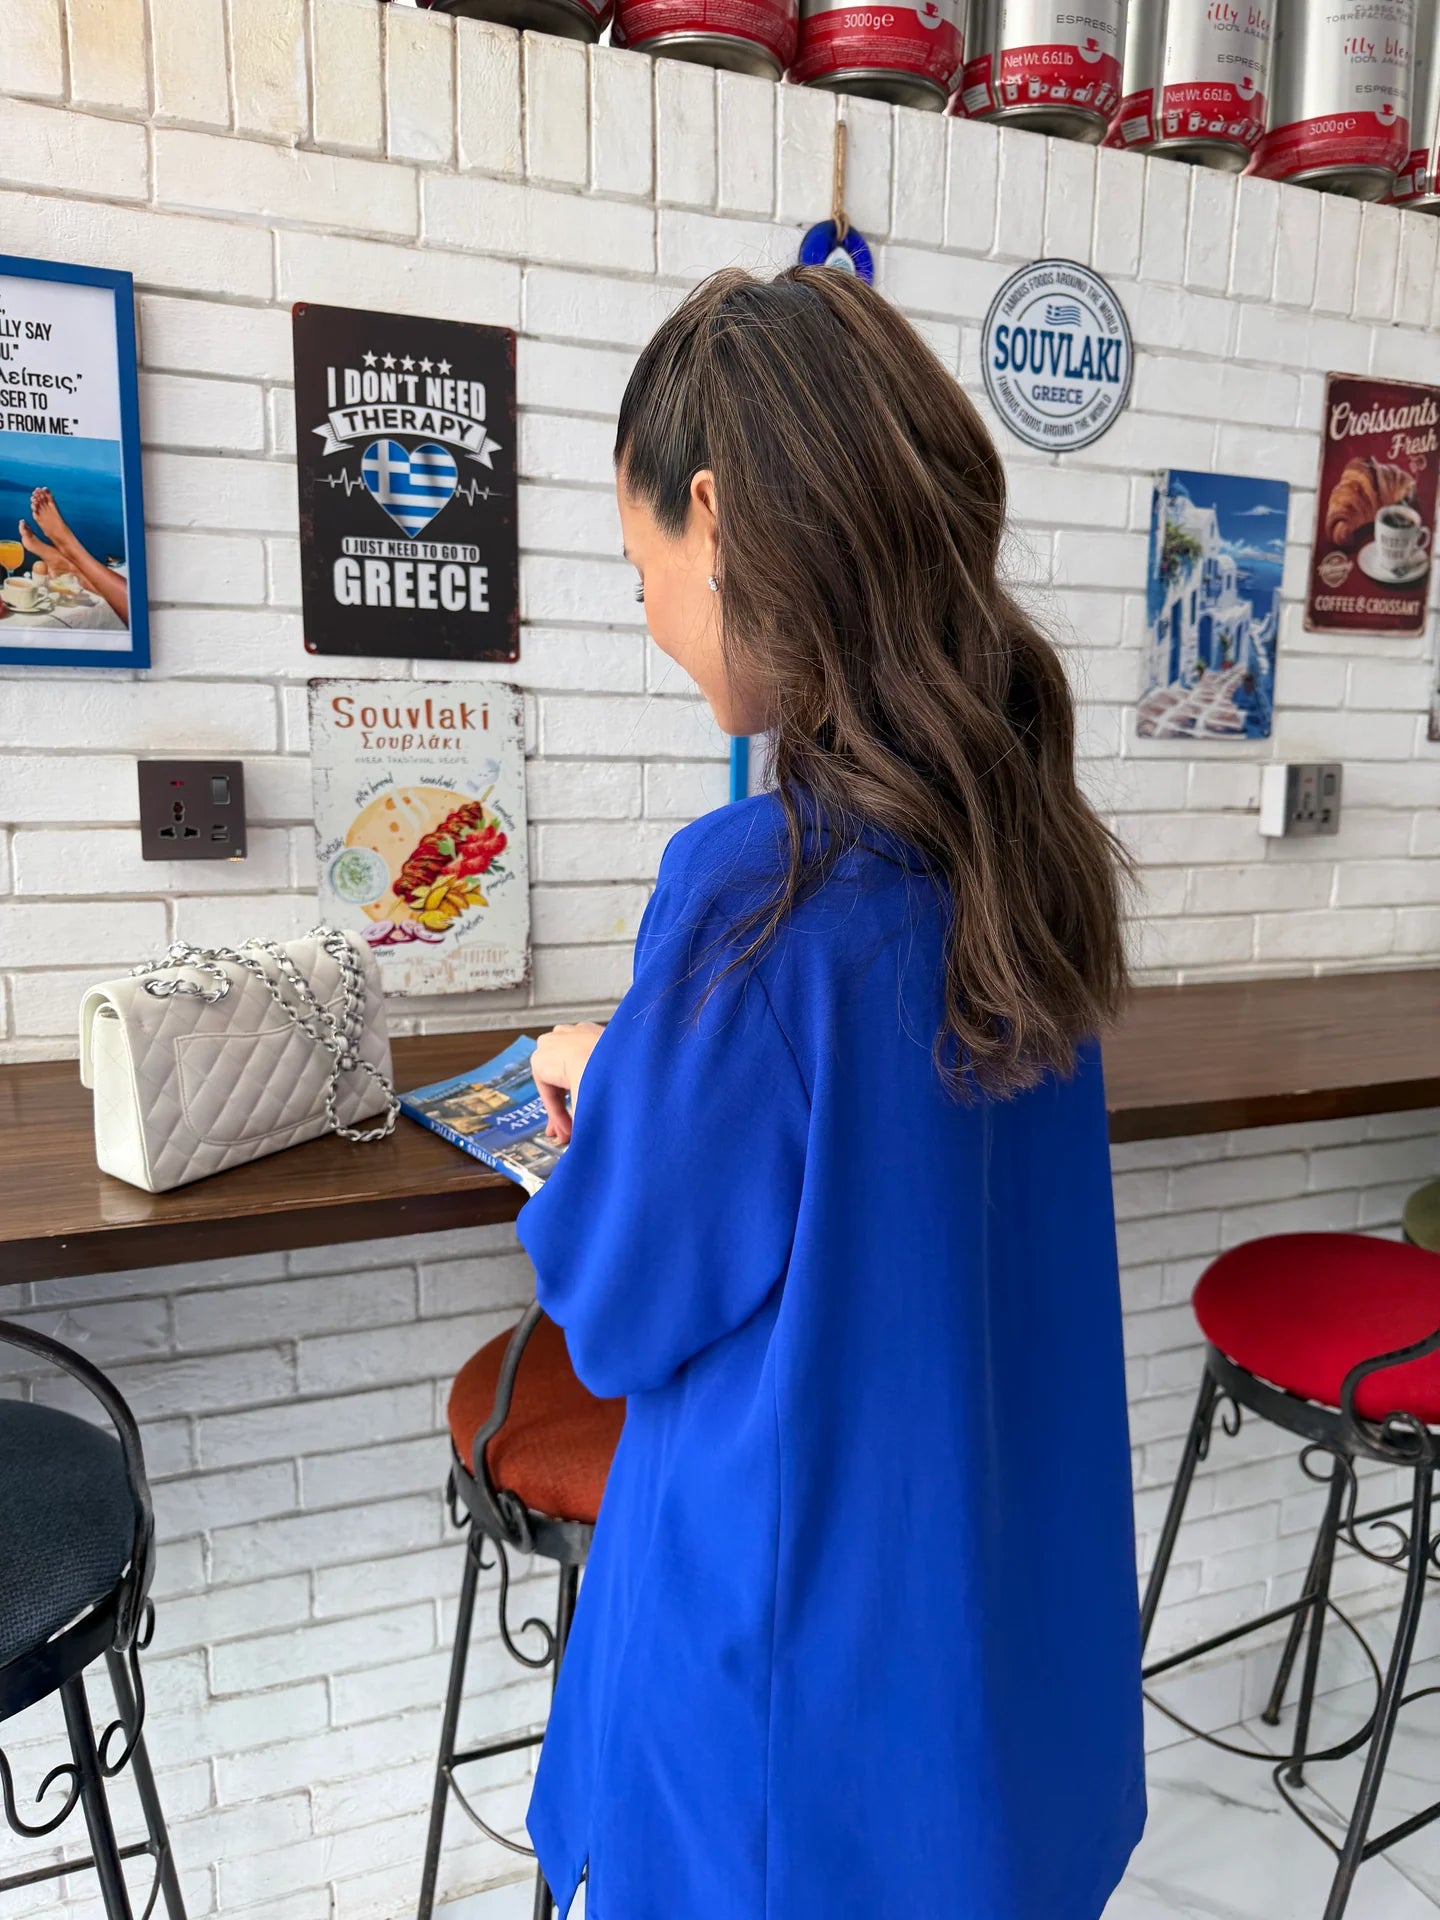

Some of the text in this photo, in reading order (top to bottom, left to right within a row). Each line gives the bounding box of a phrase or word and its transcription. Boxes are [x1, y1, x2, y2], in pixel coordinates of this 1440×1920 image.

[1207, 2, 1239, 25] illy
[1344, 37, 1375, 56] illy
[1004, 55, 1023, 68] Net
[1165, 91, 1185, 103] Net
[1086, 285, 1102, 305] THE
[25, 321, 52, 341] SAY
[993, 324, 1122, 384] SOUVLAKI
[29, 391, 48, 410] TO
[327, 367, 486, 422] I DON'T NEED
[1031, 385, 1083, 405] GREECE
[7, 413, 46, 433] FROM
[342, 408, 473, 441] THERAPY
[1329, 397, 1439, 441] Croissants
[1387, 427, 1438, 460] Fresh
[345, 538, 477, 562] I JUST NEED TO GO TO
[333, 557, 490, 613] GREECE
[1314, 595, 1355, 613] COFFEE
[1366, 597, 1420, 616] CROISSANT
[332, 697, 490, 731] Souvlaki
[361, 731, 462, 752] Σουβλάκι
